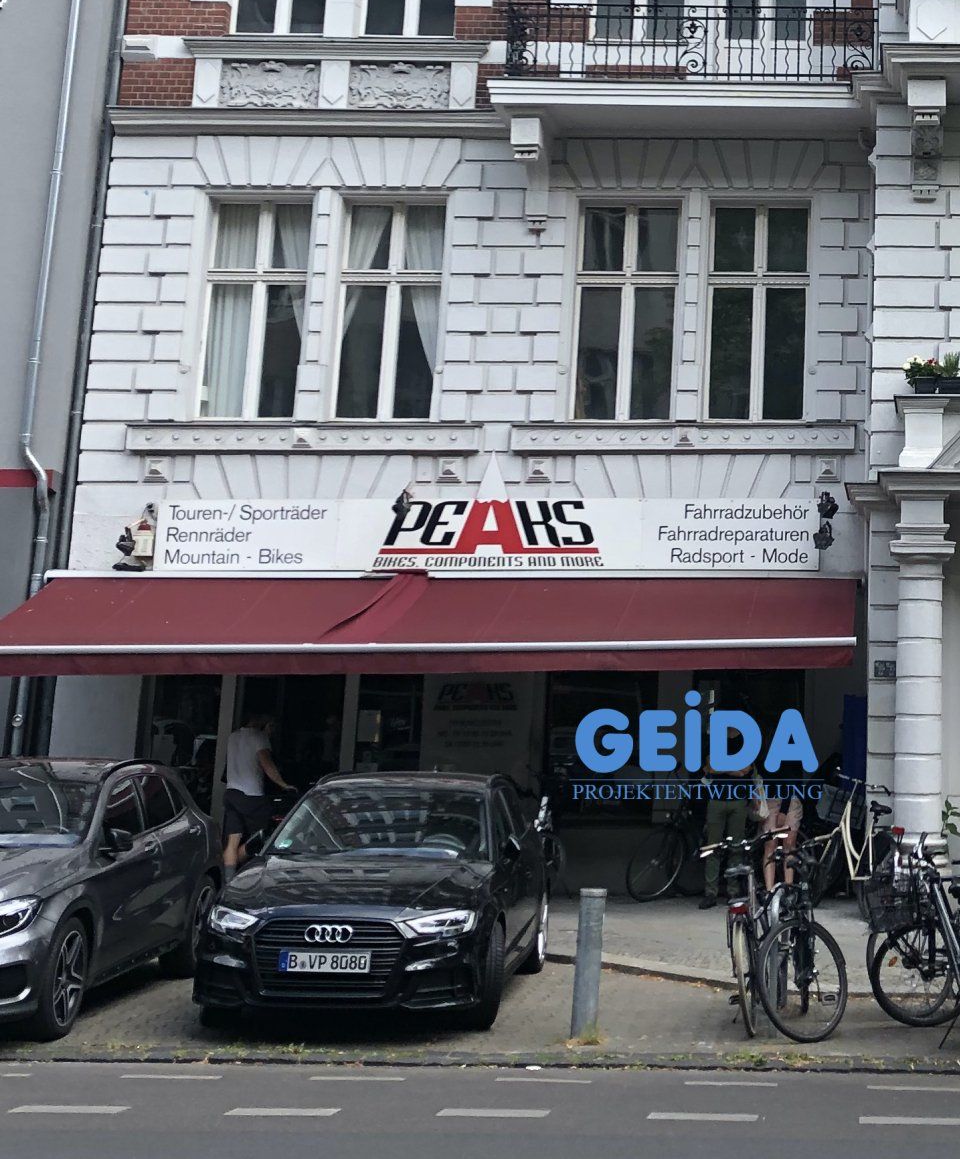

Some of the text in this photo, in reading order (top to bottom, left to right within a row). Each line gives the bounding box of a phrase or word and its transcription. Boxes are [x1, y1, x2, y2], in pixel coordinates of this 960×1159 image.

[169, 504, 327, 523] Touren-/ Sporträder
[684, 504, 809, 520] Fahrradzubehör
[383, 500, 595, 549] PEAKS
[166, 526, 252, 543] Rennräder
[658, 525, 809, 545] Fahrradreparaturen
[164, 548, 241, 565] Mountain
[258, 548, 303, 564] Bikes
[425, 556, 523, 568] COMPONENTS
[528, 556, 556, 567] AND
[560, 556, 604, 567] MORE
[670, 548, 744, 567] Radsport
[762, 548, 808, 564] Mode
[288, 954, 298, 969] B
[308, 955, 327, 970] VP
